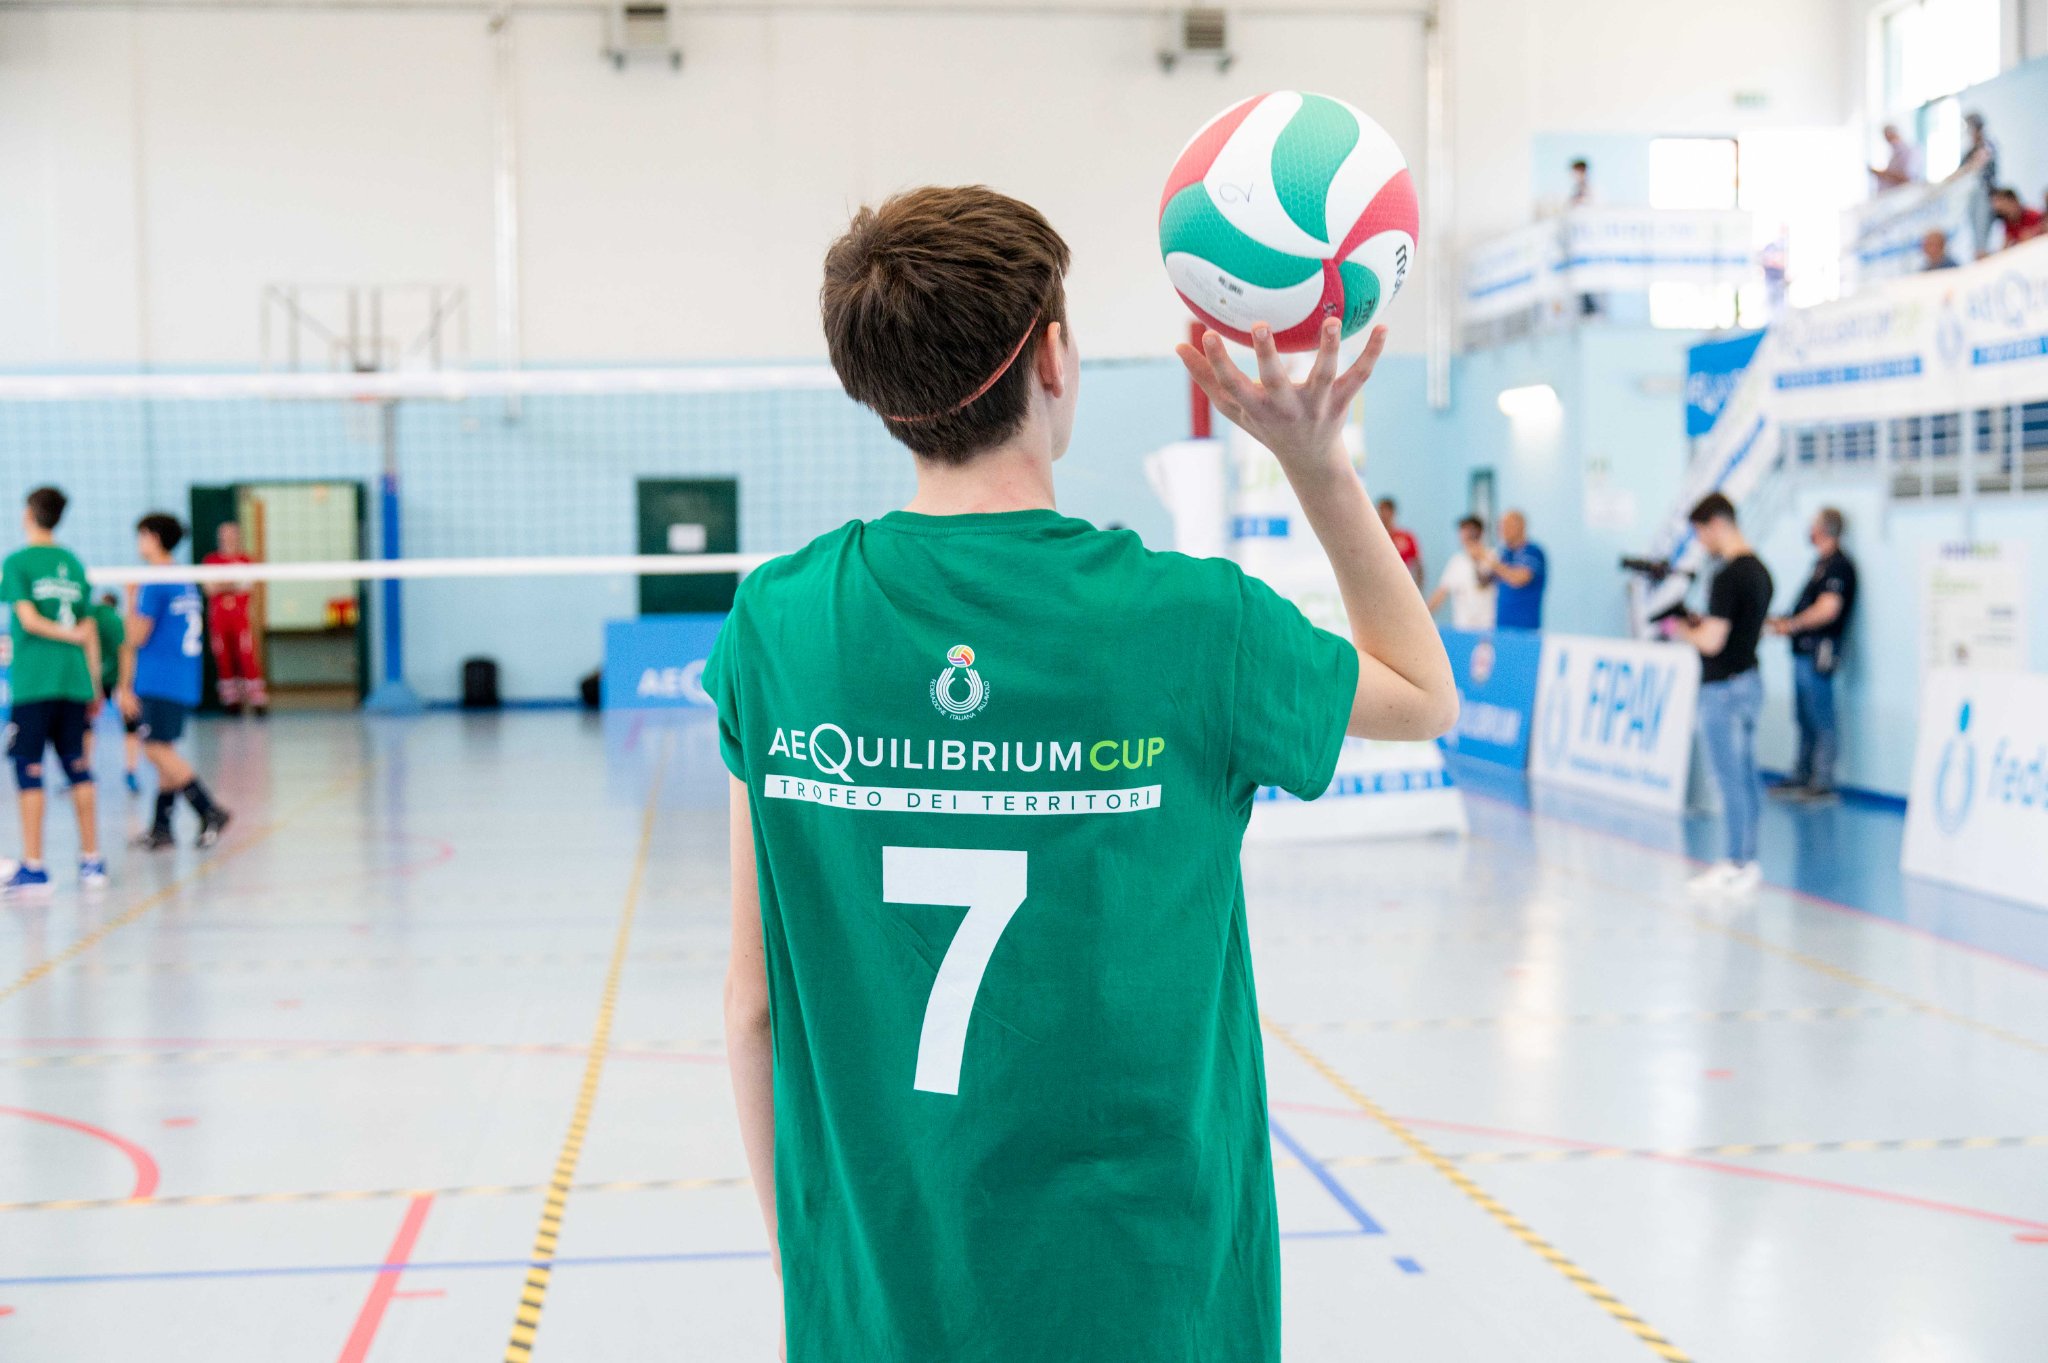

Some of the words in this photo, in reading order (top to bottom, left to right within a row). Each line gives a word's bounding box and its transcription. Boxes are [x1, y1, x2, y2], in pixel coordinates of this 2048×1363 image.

[929, 679, 947, 716] FEDERAZIONE
[949, 711, 977, 721] ITALIANA
[976, 680, 990, 713] PALLAVOLO
[1580, 657, 1676, 753] FIPAV
[780, 779, 882, 807] TROFEO
[907, 793, 957, 809] DEI
[982, 790, 1150, 811] TERRITORI
[882, 845, 1028, 1096] 7
